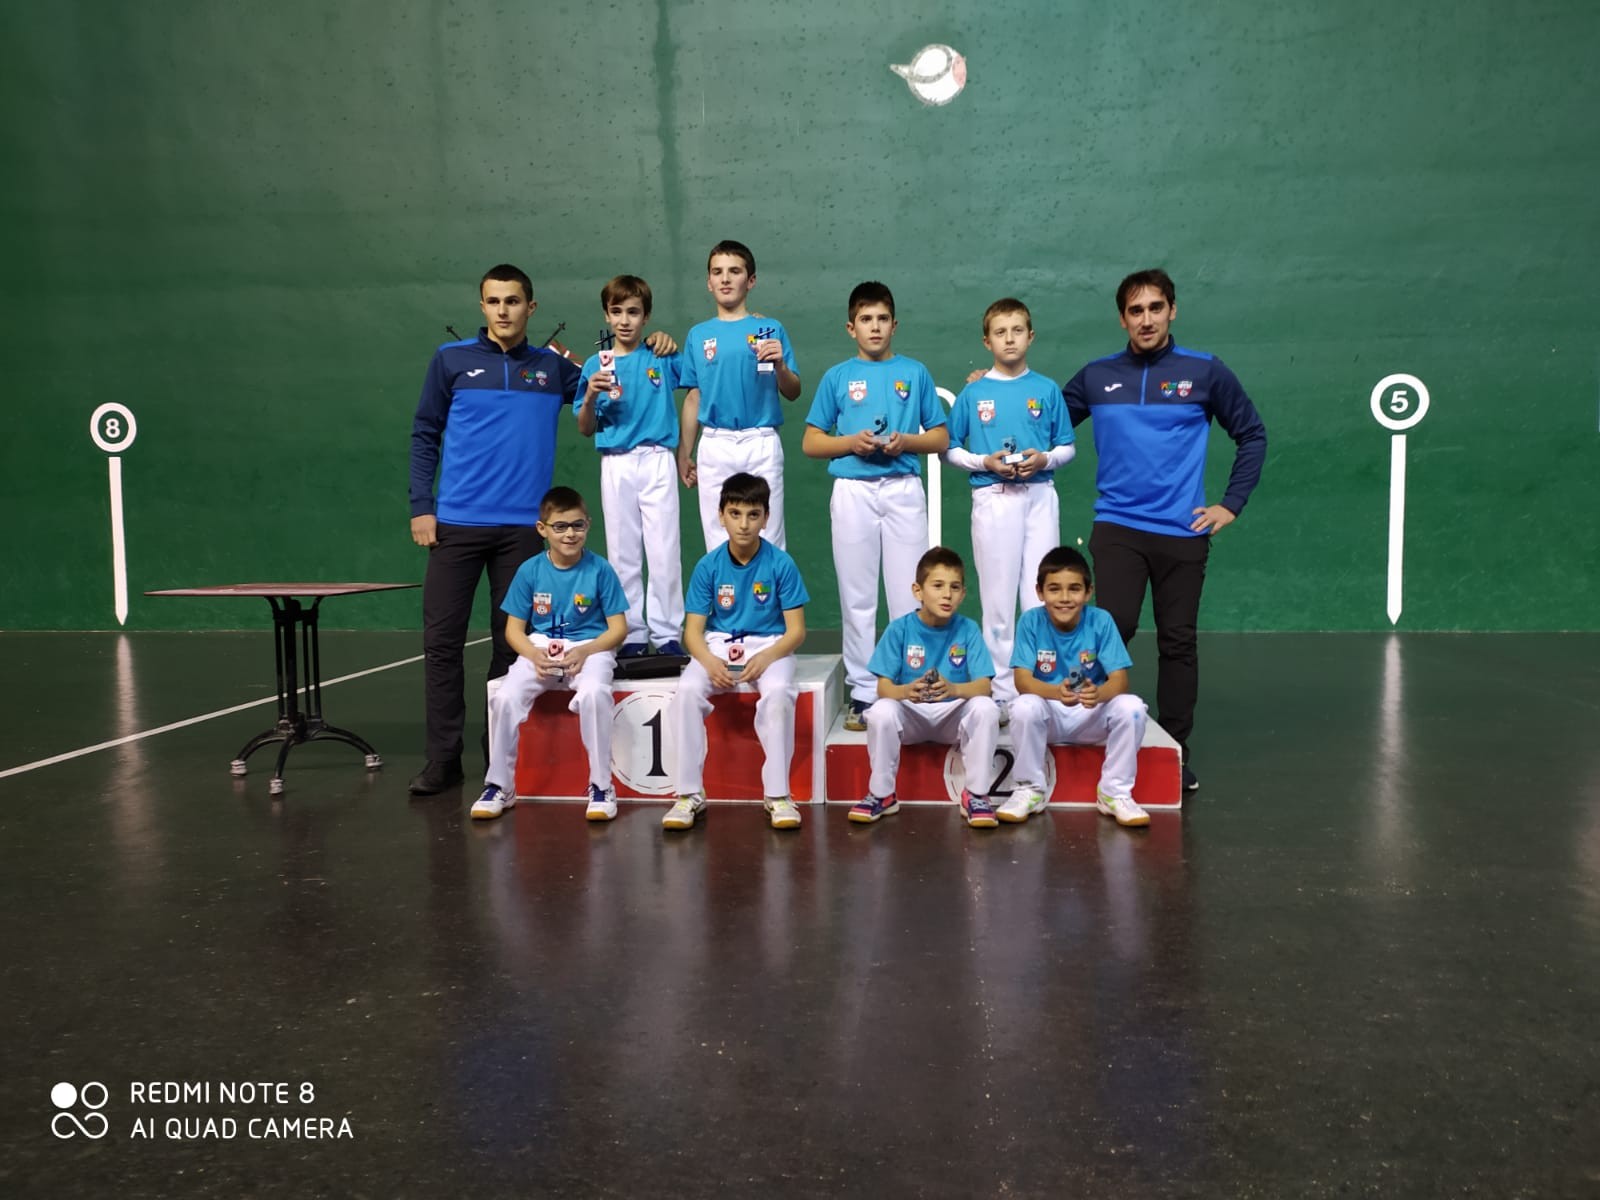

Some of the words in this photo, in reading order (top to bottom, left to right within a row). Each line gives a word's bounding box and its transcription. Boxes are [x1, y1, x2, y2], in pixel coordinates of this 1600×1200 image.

[1390, 390, 1409, 413] 5
[105, 418, 120, 438] 8
[642, 709, 668, 776] 1
[987, 748, 1015, 797] 2
